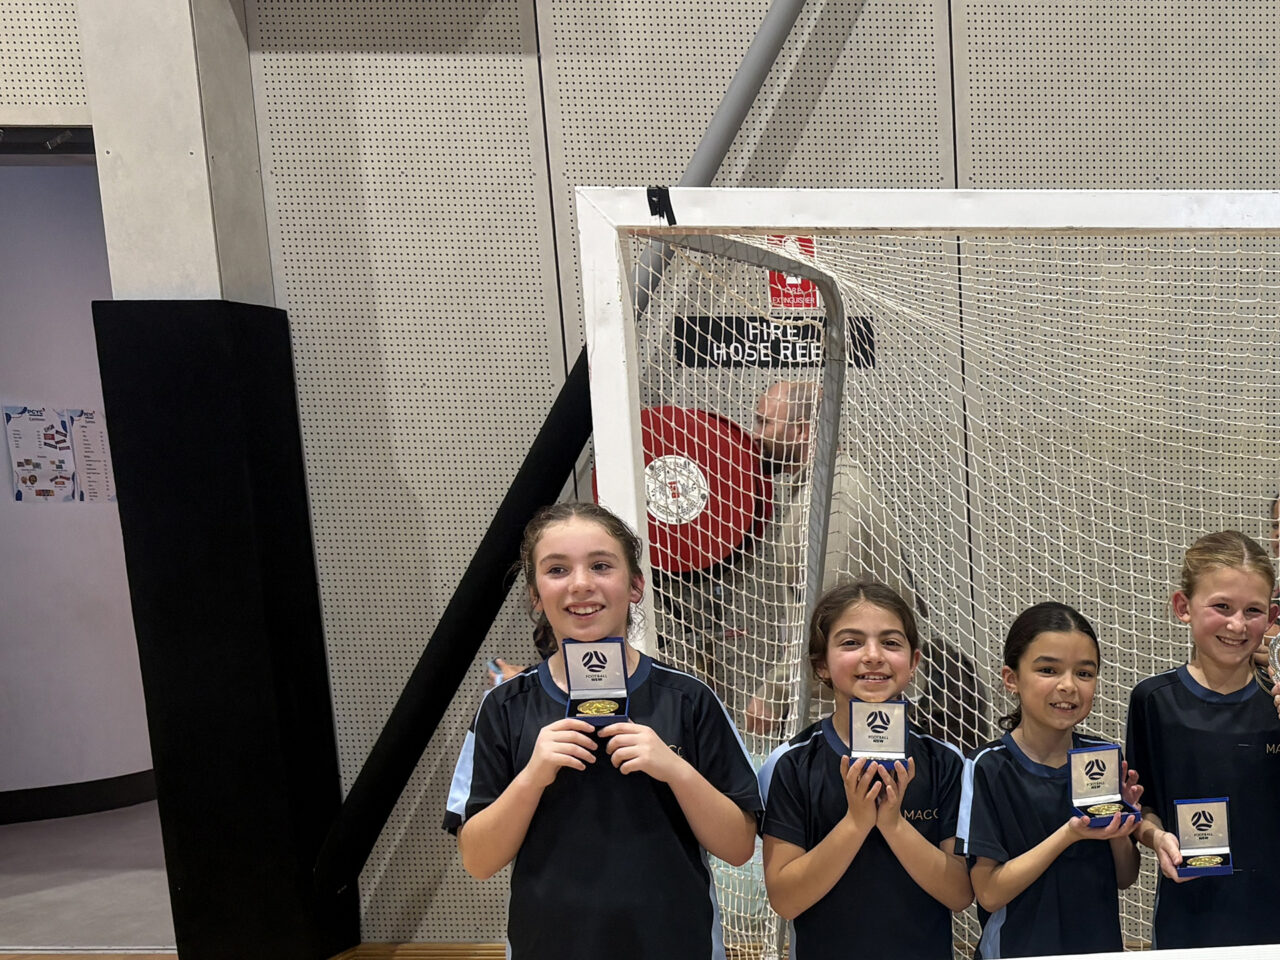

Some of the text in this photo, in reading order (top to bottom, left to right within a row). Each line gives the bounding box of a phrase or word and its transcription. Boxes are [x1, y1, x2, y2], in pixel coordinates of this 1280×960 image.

[772, 296, 816, 305] EXTINGUISHER
[749, 322, 800, 342] FIRE
[713, 342, 823, 362] HOSE REE
